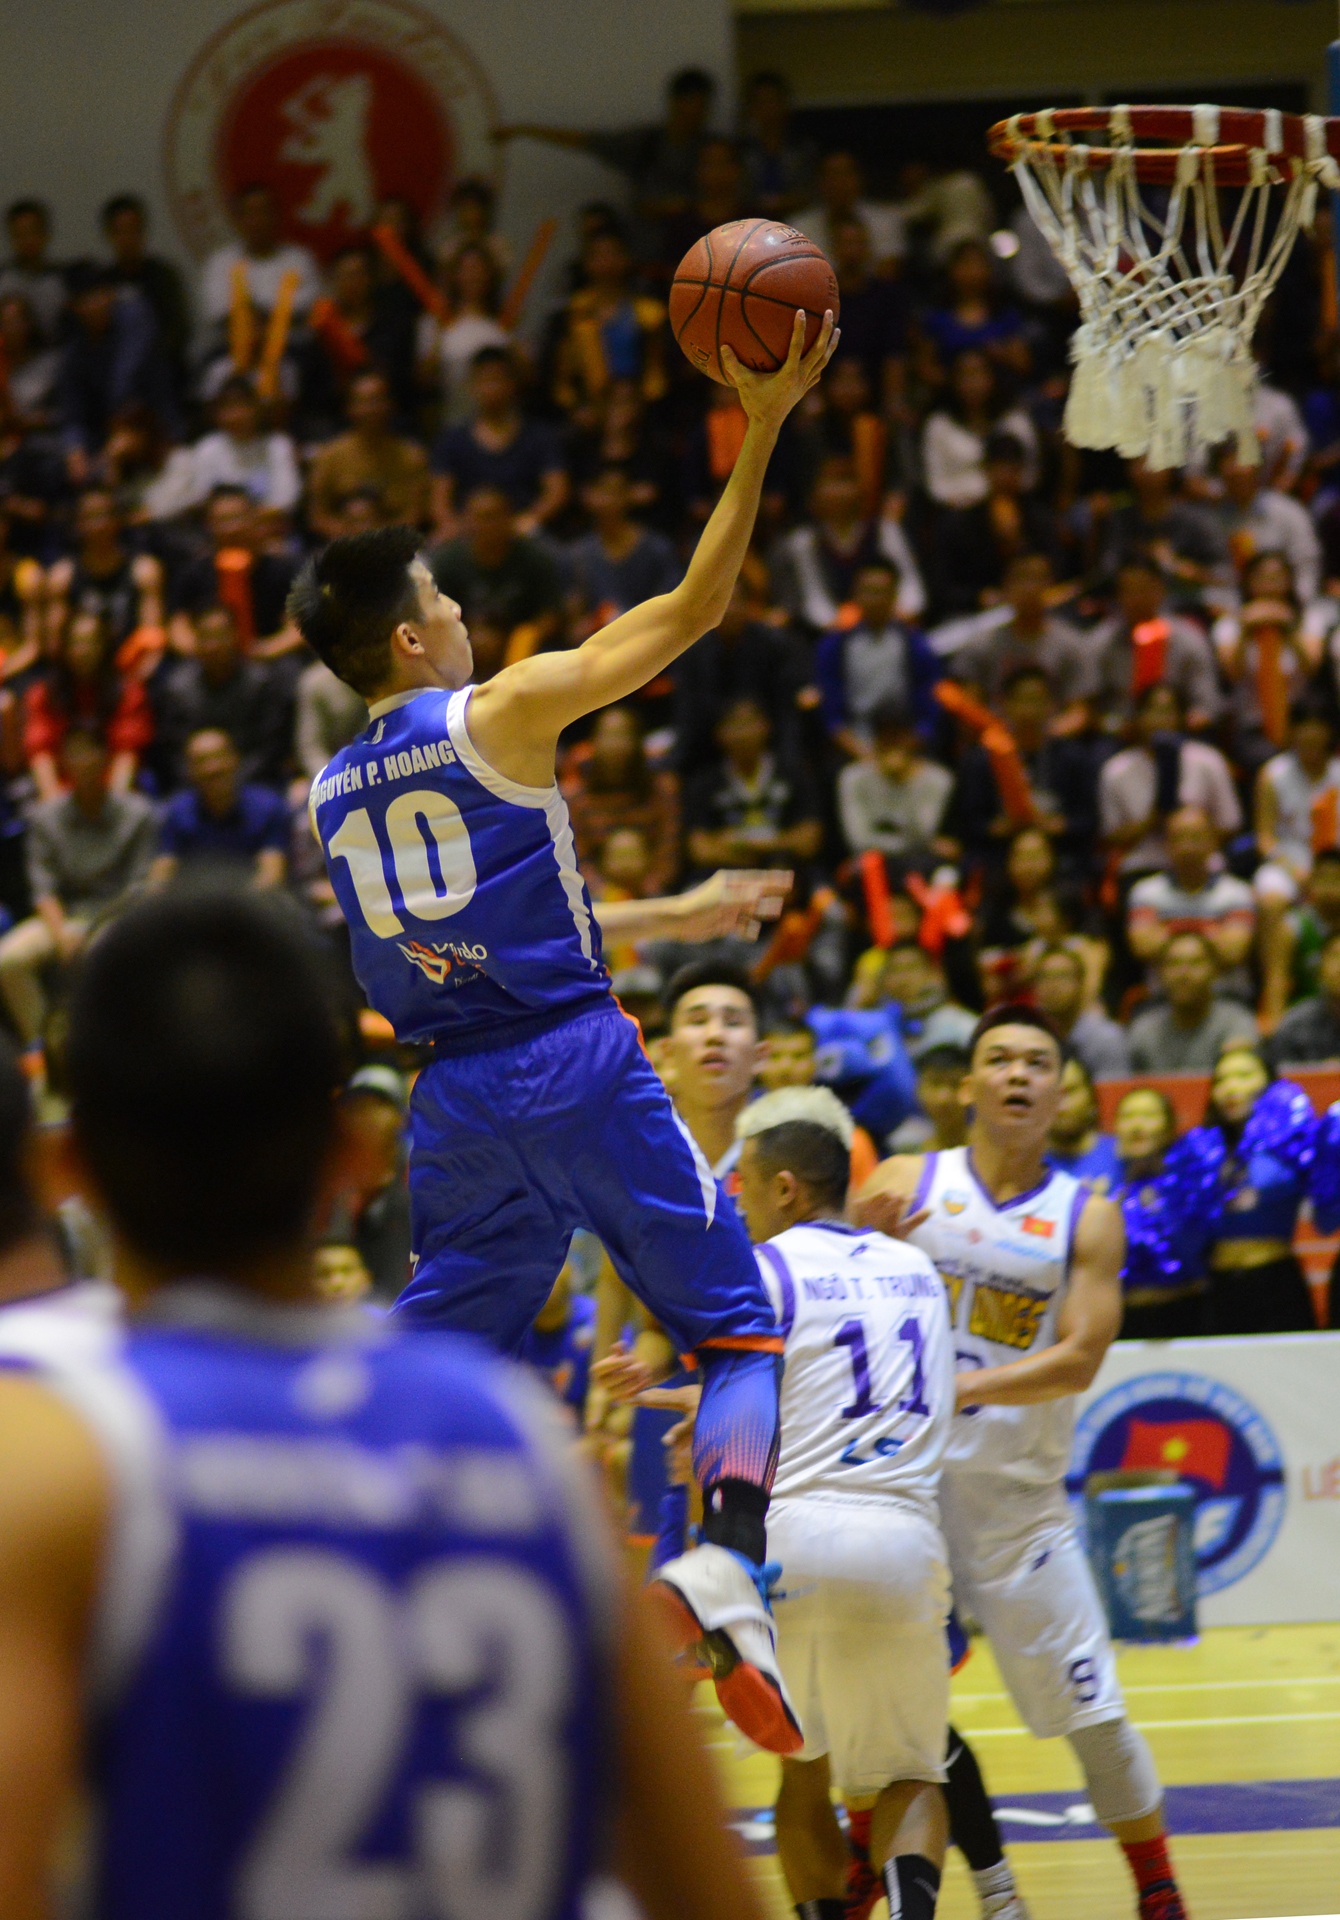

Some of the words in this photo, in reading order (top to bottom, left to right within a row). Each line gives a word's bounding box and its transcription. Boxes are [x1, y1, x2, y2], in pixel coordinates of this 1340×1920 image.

[366, 761, 382, 787] P.
[383, 739, 457, 782] HOÀNG
[328, 790, 477, 939] 10
[832, 1316, 931, 1420] 11
[218, 1545, 573, 1920] 23
